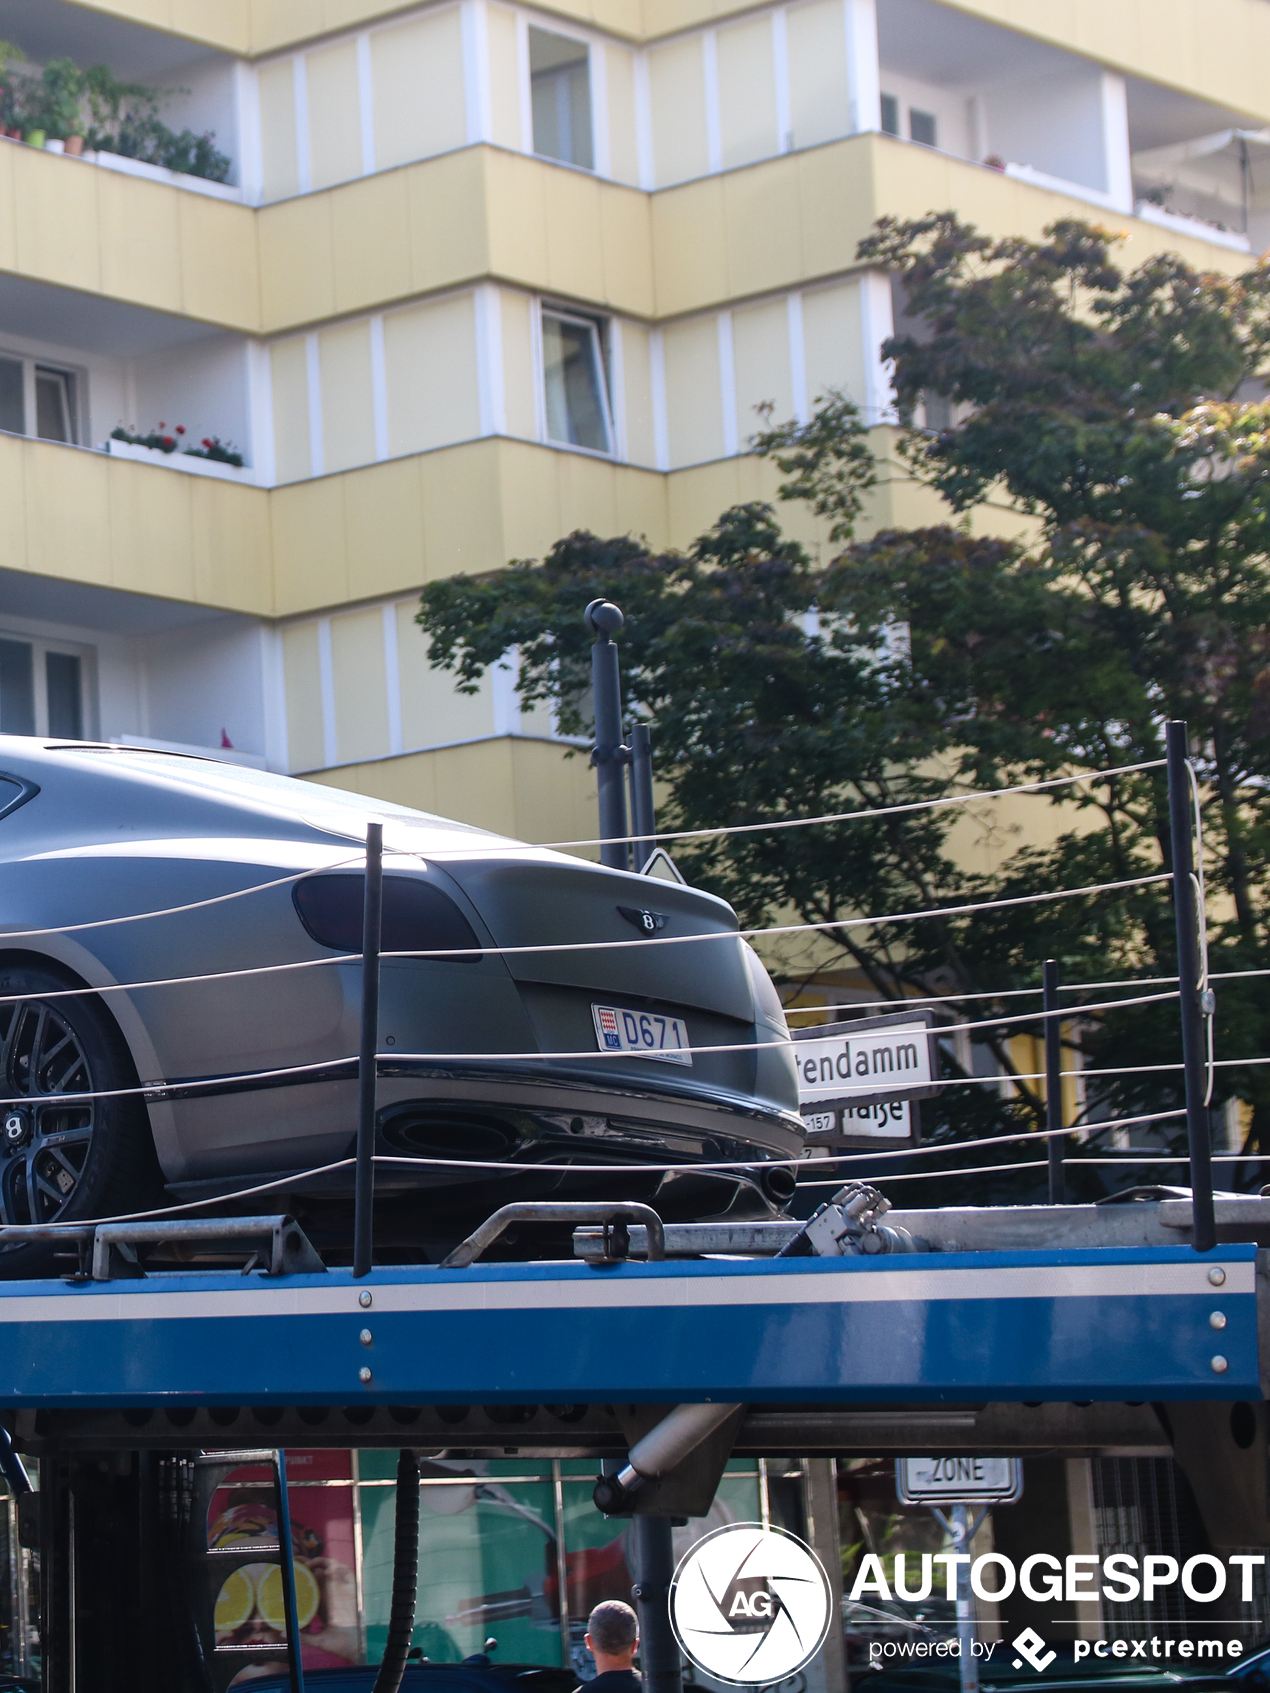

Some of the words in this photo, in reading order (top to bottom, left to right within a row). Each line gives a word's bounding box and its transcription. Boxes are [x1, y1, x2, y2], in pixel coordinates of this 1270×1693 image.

[607, 1035, 619, 1046] MC
[622, 1012, 682, 1049] D671
[931, 1457, 984, 1482] ZONE
